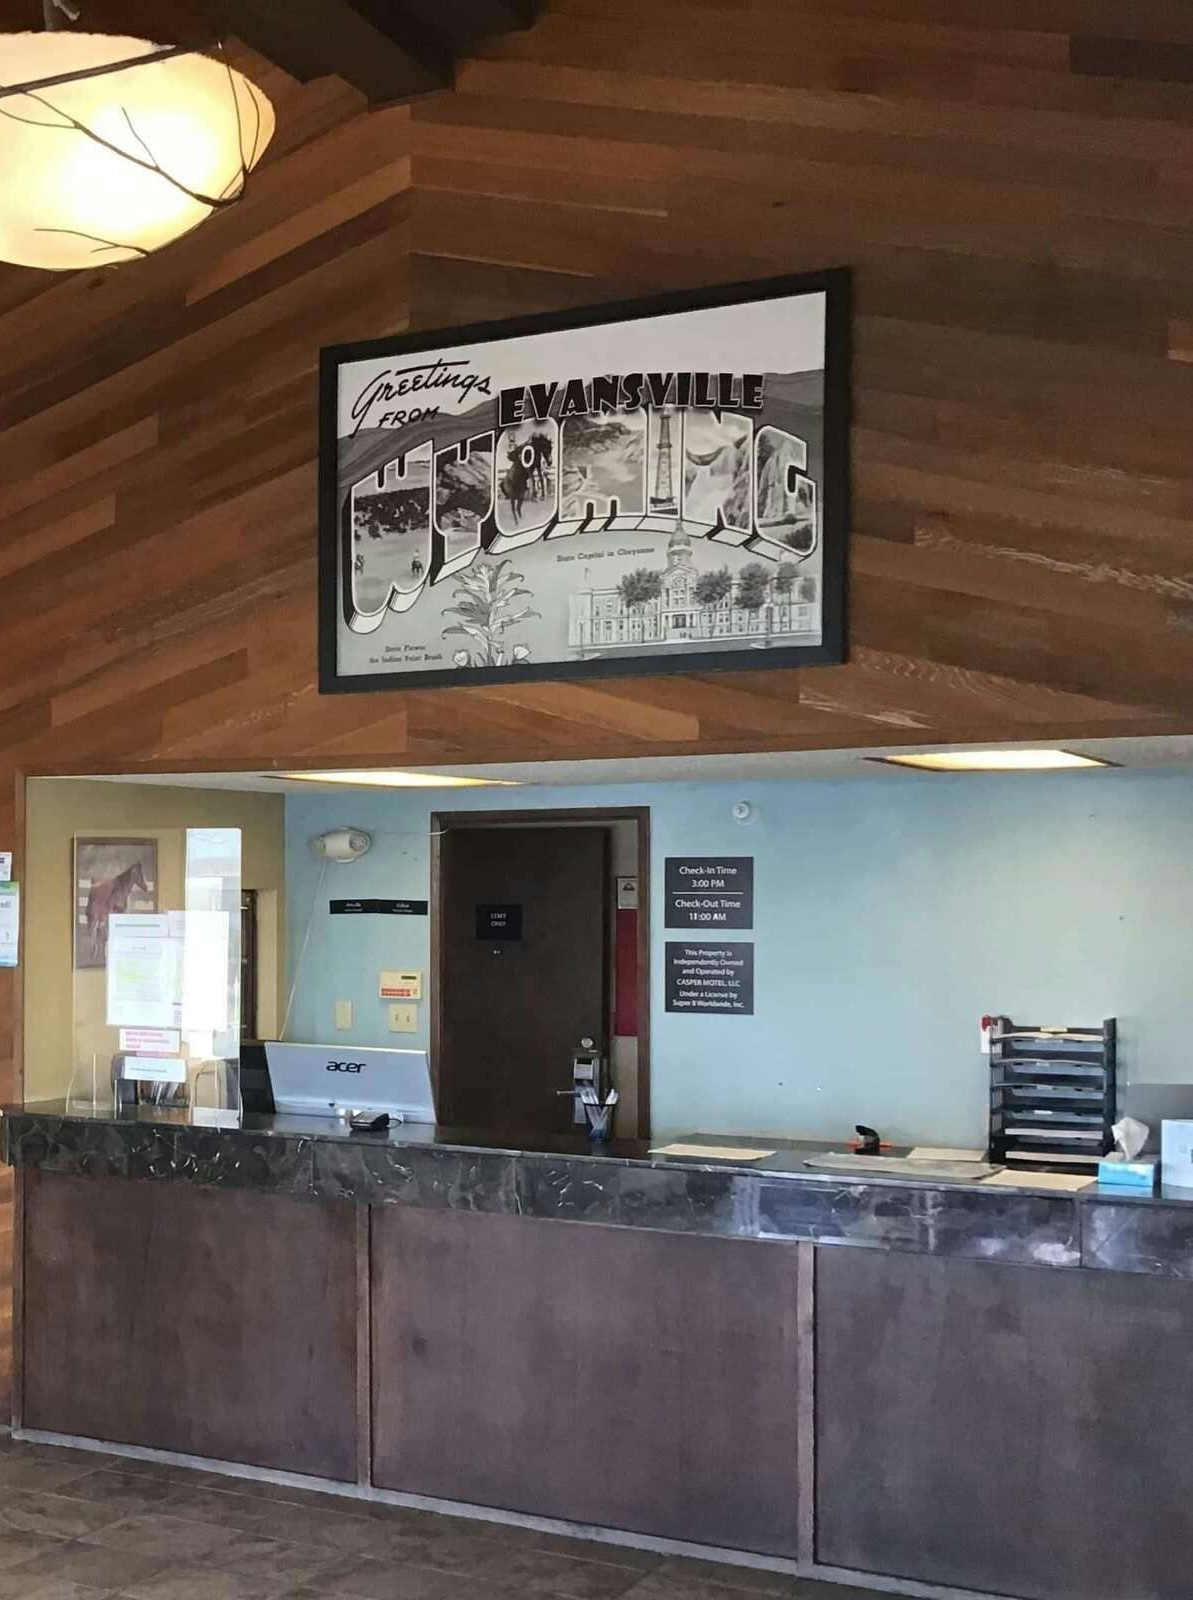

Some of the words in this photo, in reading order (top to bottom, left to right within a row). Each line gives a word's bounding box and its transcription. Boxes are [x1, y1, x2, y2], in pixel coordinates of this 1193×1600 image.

[351, 358, 492, 439] Greetings
[498, 371, 765, 427] EVANSVILLE
[378, 406, 440, 428] FROM
[343, 404, 819, 634] WYOMING
[679, 866, 715, 875] Check-In
[716, 866, 737, 875] Time
[691, 879, 709, 888] 3:00
[710, 879, 725, 888] PM
[675, 899, 719, 908] Check-Out
[720, 899, 741, 908] Time
[689, 912, 711, 921] 11:00
[712, 912, 726, 921] AM
[698, 949, 725, 957] Property
[673, 958, 719, 966] Independently
[695, 968, 725, 976] Operated
[726, 968, 735, 976] by
[326, 1060, 366, 1073] acer
